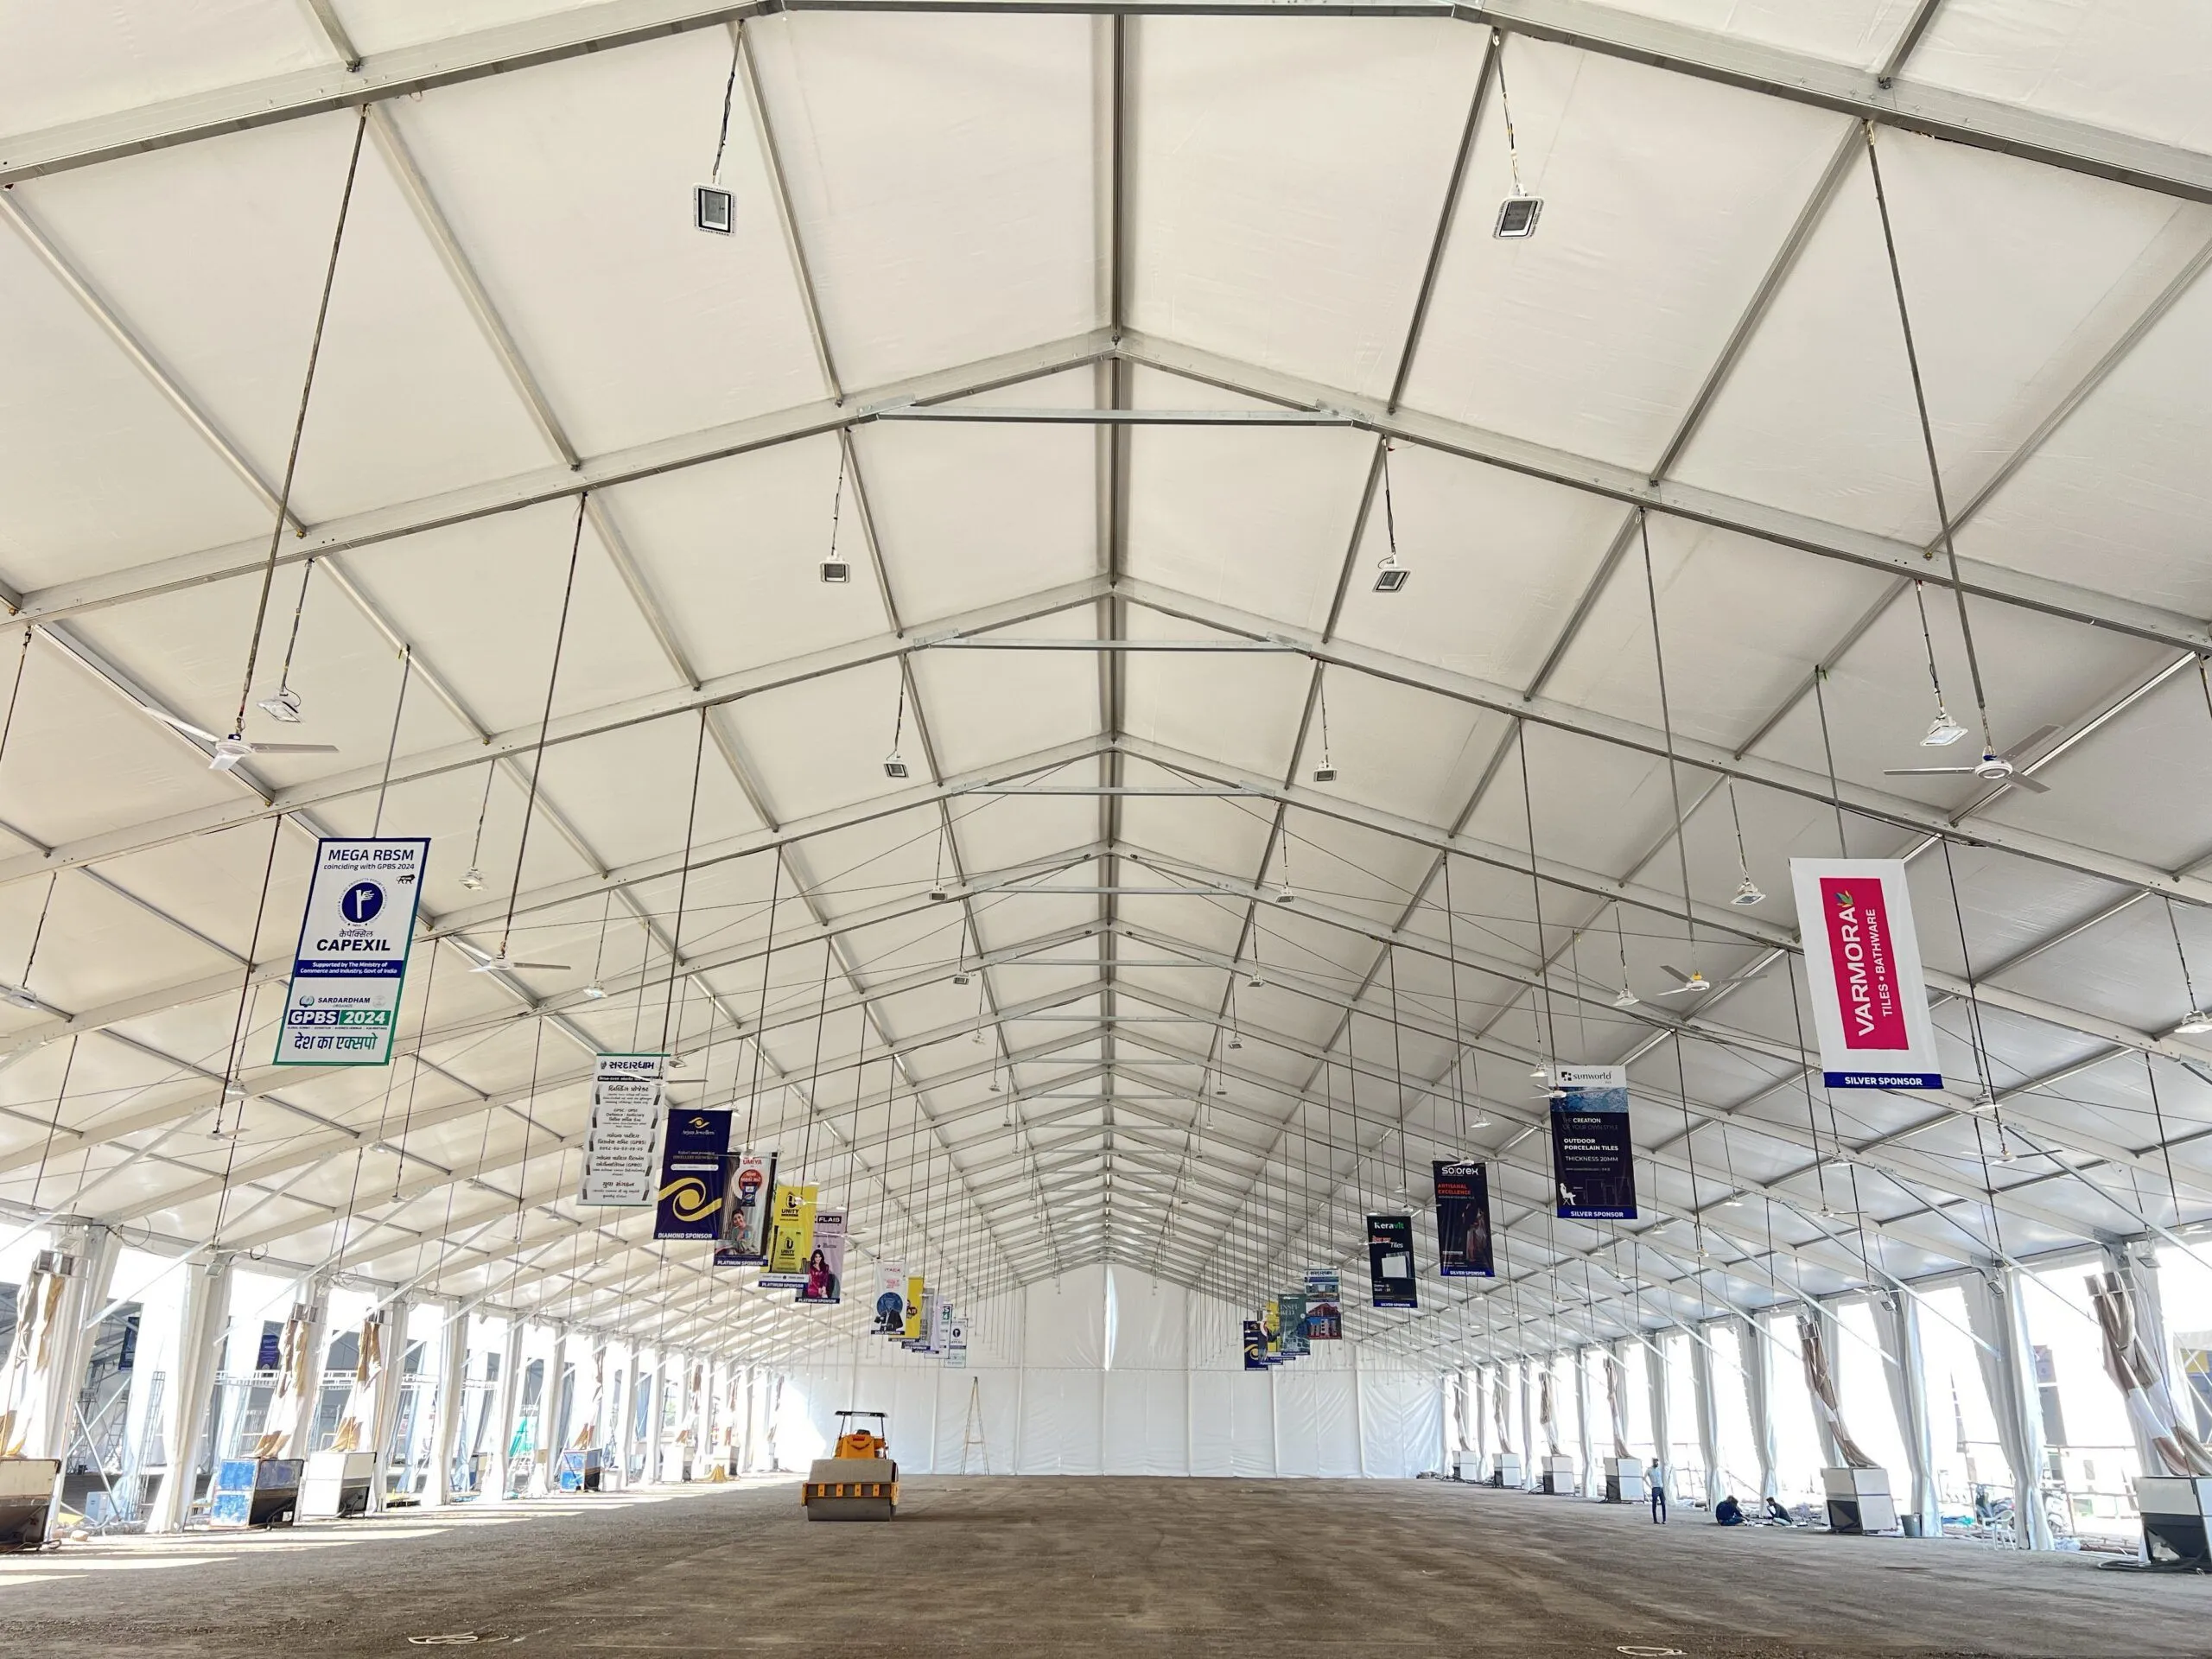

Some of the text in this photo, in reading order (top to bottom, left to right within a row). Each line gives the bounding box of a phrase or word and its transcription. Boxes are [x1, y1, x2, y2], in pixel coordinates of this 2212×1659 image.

[328, 849, 414, 861] MEGA RBSM
[317, 939, 391, 951] CAPEXIL
[1866, 909, 1892, 1017] TILES BATHWARE
[1839, 907, 1875, 1036] VARMORA
[290, 1010, 386, 1024] GPBS 2024
[295, 1032, 378, 1050] देश का एक्सपो
[609, 1061, 655, 1069] સરદારધામ
